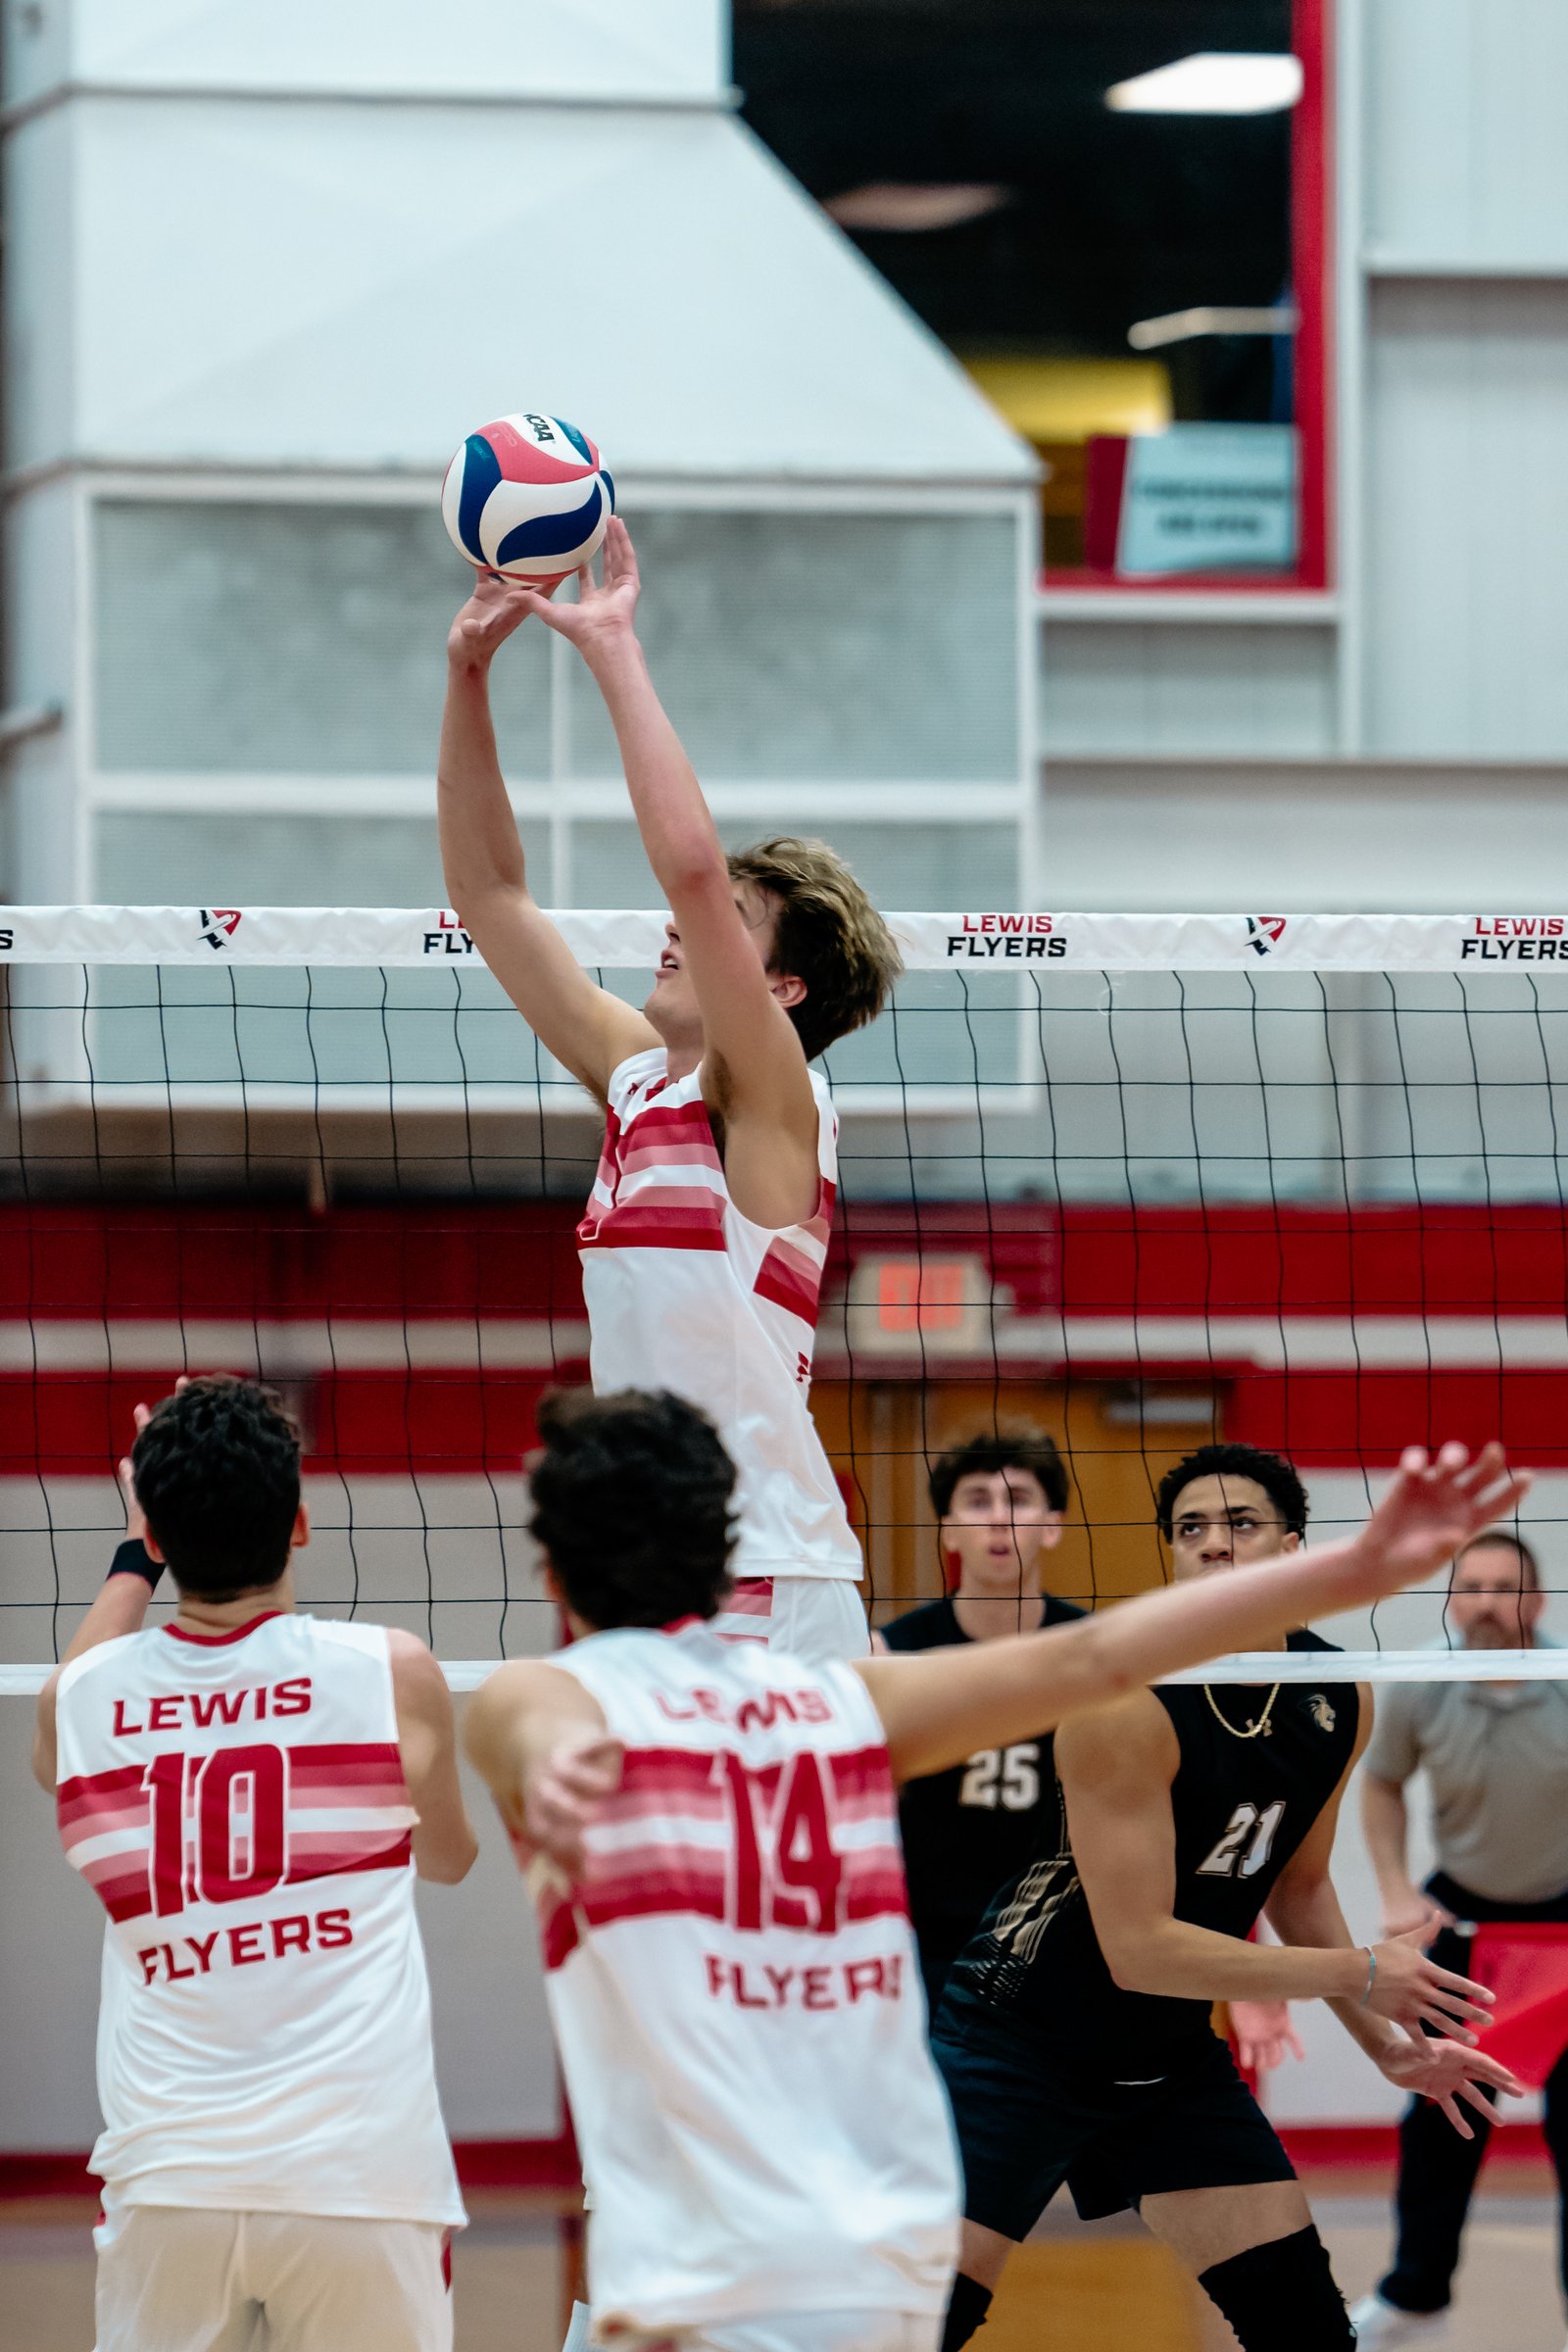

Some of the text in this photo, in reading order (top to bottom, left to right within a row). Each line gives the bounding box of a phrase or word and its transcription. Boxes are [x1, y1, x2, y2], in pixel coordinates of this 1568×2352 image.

[947, 936, 1067, 957] FLYERS
[962, 914, 1053, 933] LEWIS
[1475, 916, 1565, 936] LEWIS
[113, 1677, 313, 1738] LEWIS
[959, 1743, 1041, 1810] 25
[144, 1743, 289, 1918] 10
[711, 1747, 846, 1936] 14
[1195, 1800, 1287, 1879] 21
[136, 1907, 355, 1986] FLYERS
